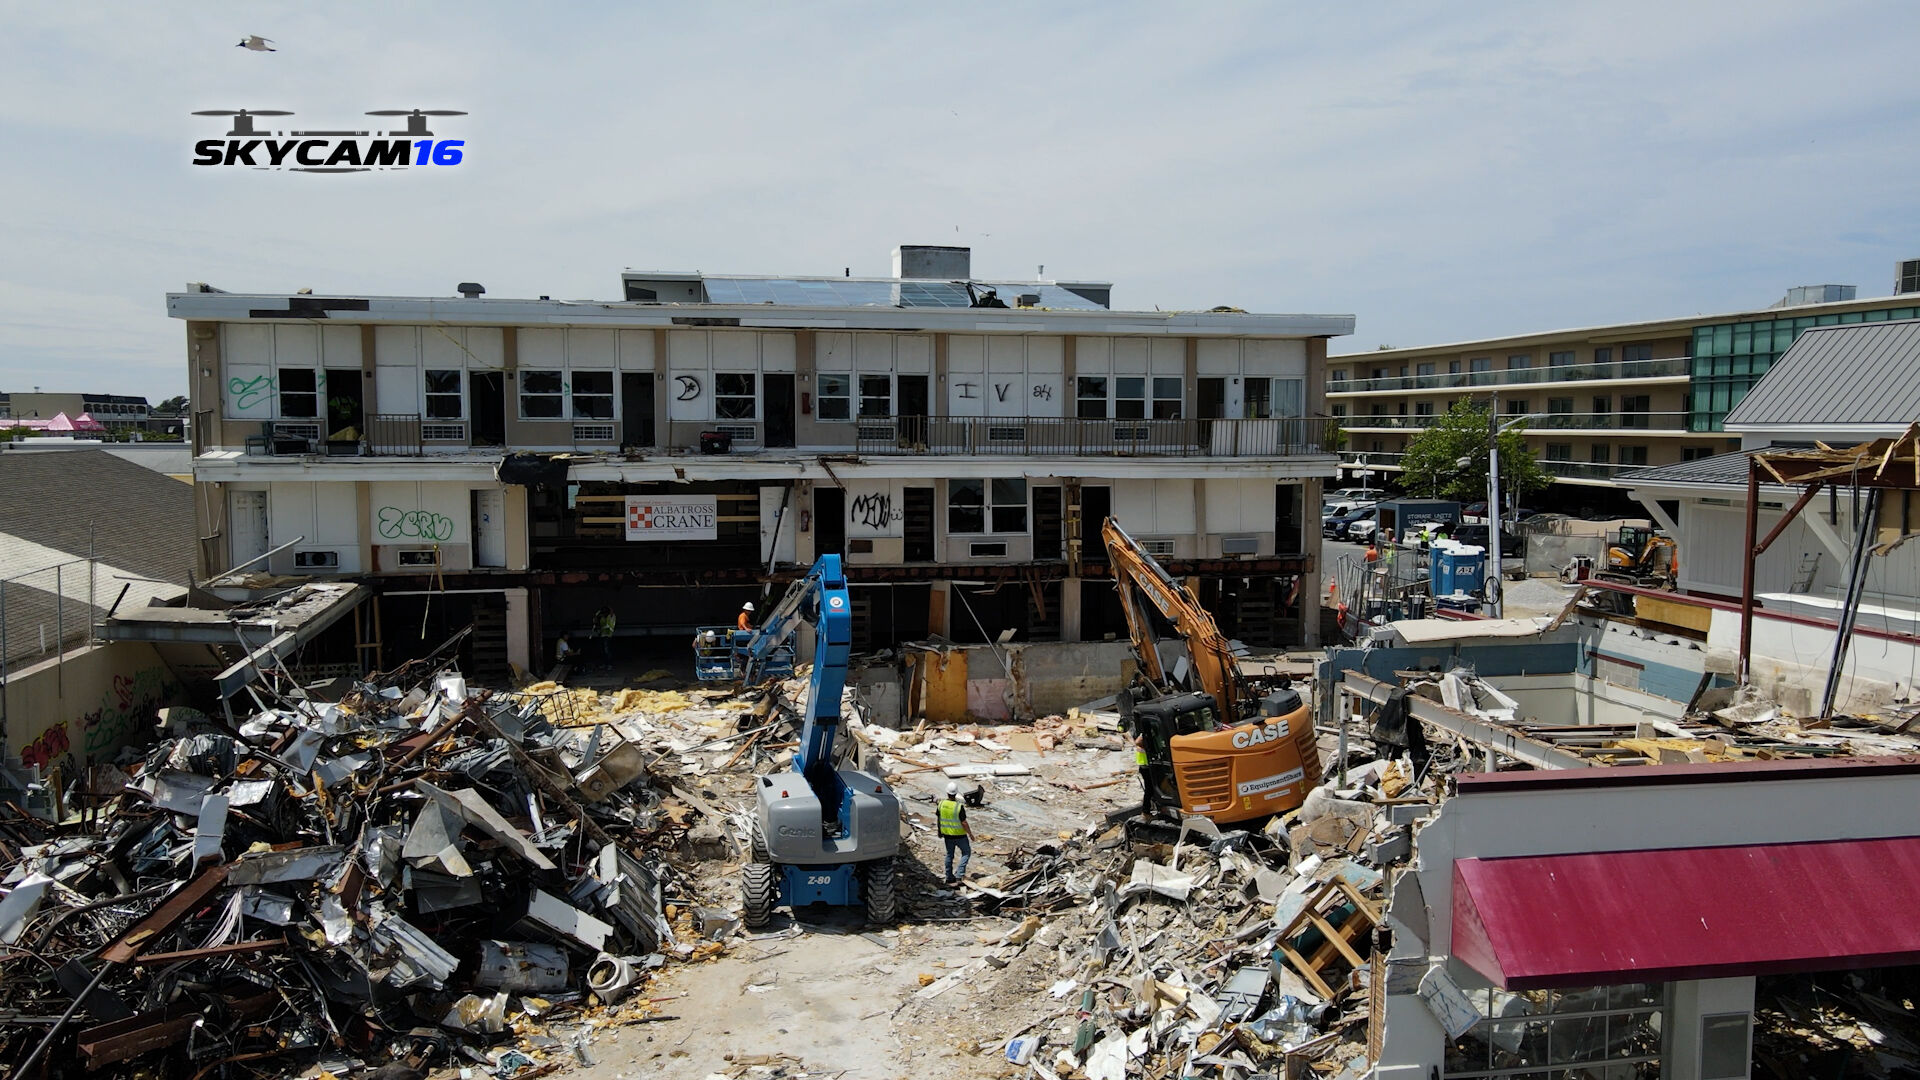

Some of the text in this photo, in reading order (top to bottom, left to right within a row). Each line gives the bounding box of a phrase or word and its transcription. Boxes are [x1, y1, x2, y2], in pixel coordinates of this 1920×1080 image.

[995, 383, 1010, 402] V
[653, 506, 714, 515] ALBATROSS
[653, 515, 714, 528] CRANE
[1139, 573, 1170, 614] CASE
[1232, 719, 1290, 749] CASE
[777, 825, 816, 838] Genie
[807, 875, 831, 885] Z-80
